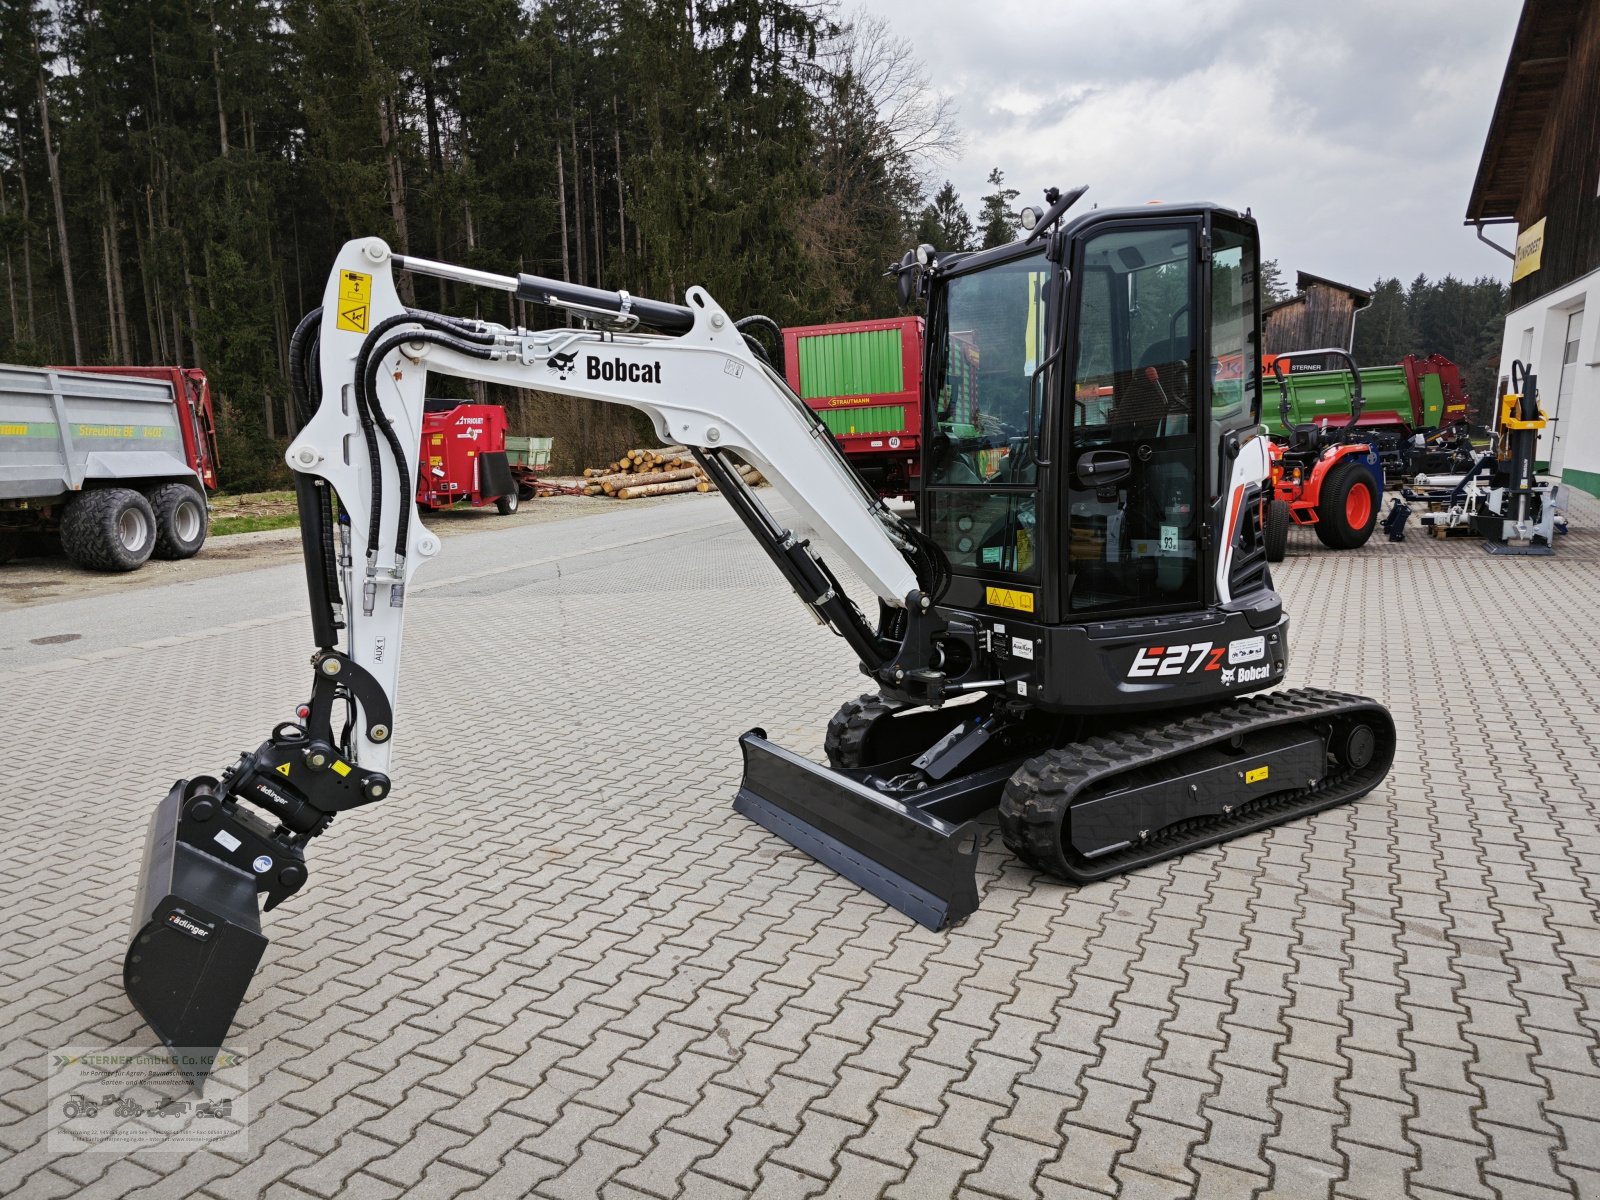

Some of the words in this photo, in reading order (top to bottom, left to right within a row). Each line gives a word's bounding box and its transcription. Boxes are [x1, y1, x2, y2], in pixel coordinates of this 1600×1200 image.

[586, 355, 662, 384] Bobcat
[831, 397, 870, 406] STRAUTMANN
[79, 424, 120, 437] Streublitz
[123, 425, 135, 437] BE
[890, 438, 898, 446] 40
[1164, 537, 1173, 549] 93
[375, 646, 383, 662] AUX
[1237, 663, 1270, 683] Bobcat
[256, 784, 288, 805] rädlinger
[169, 914, 209, 937] rädlinger
